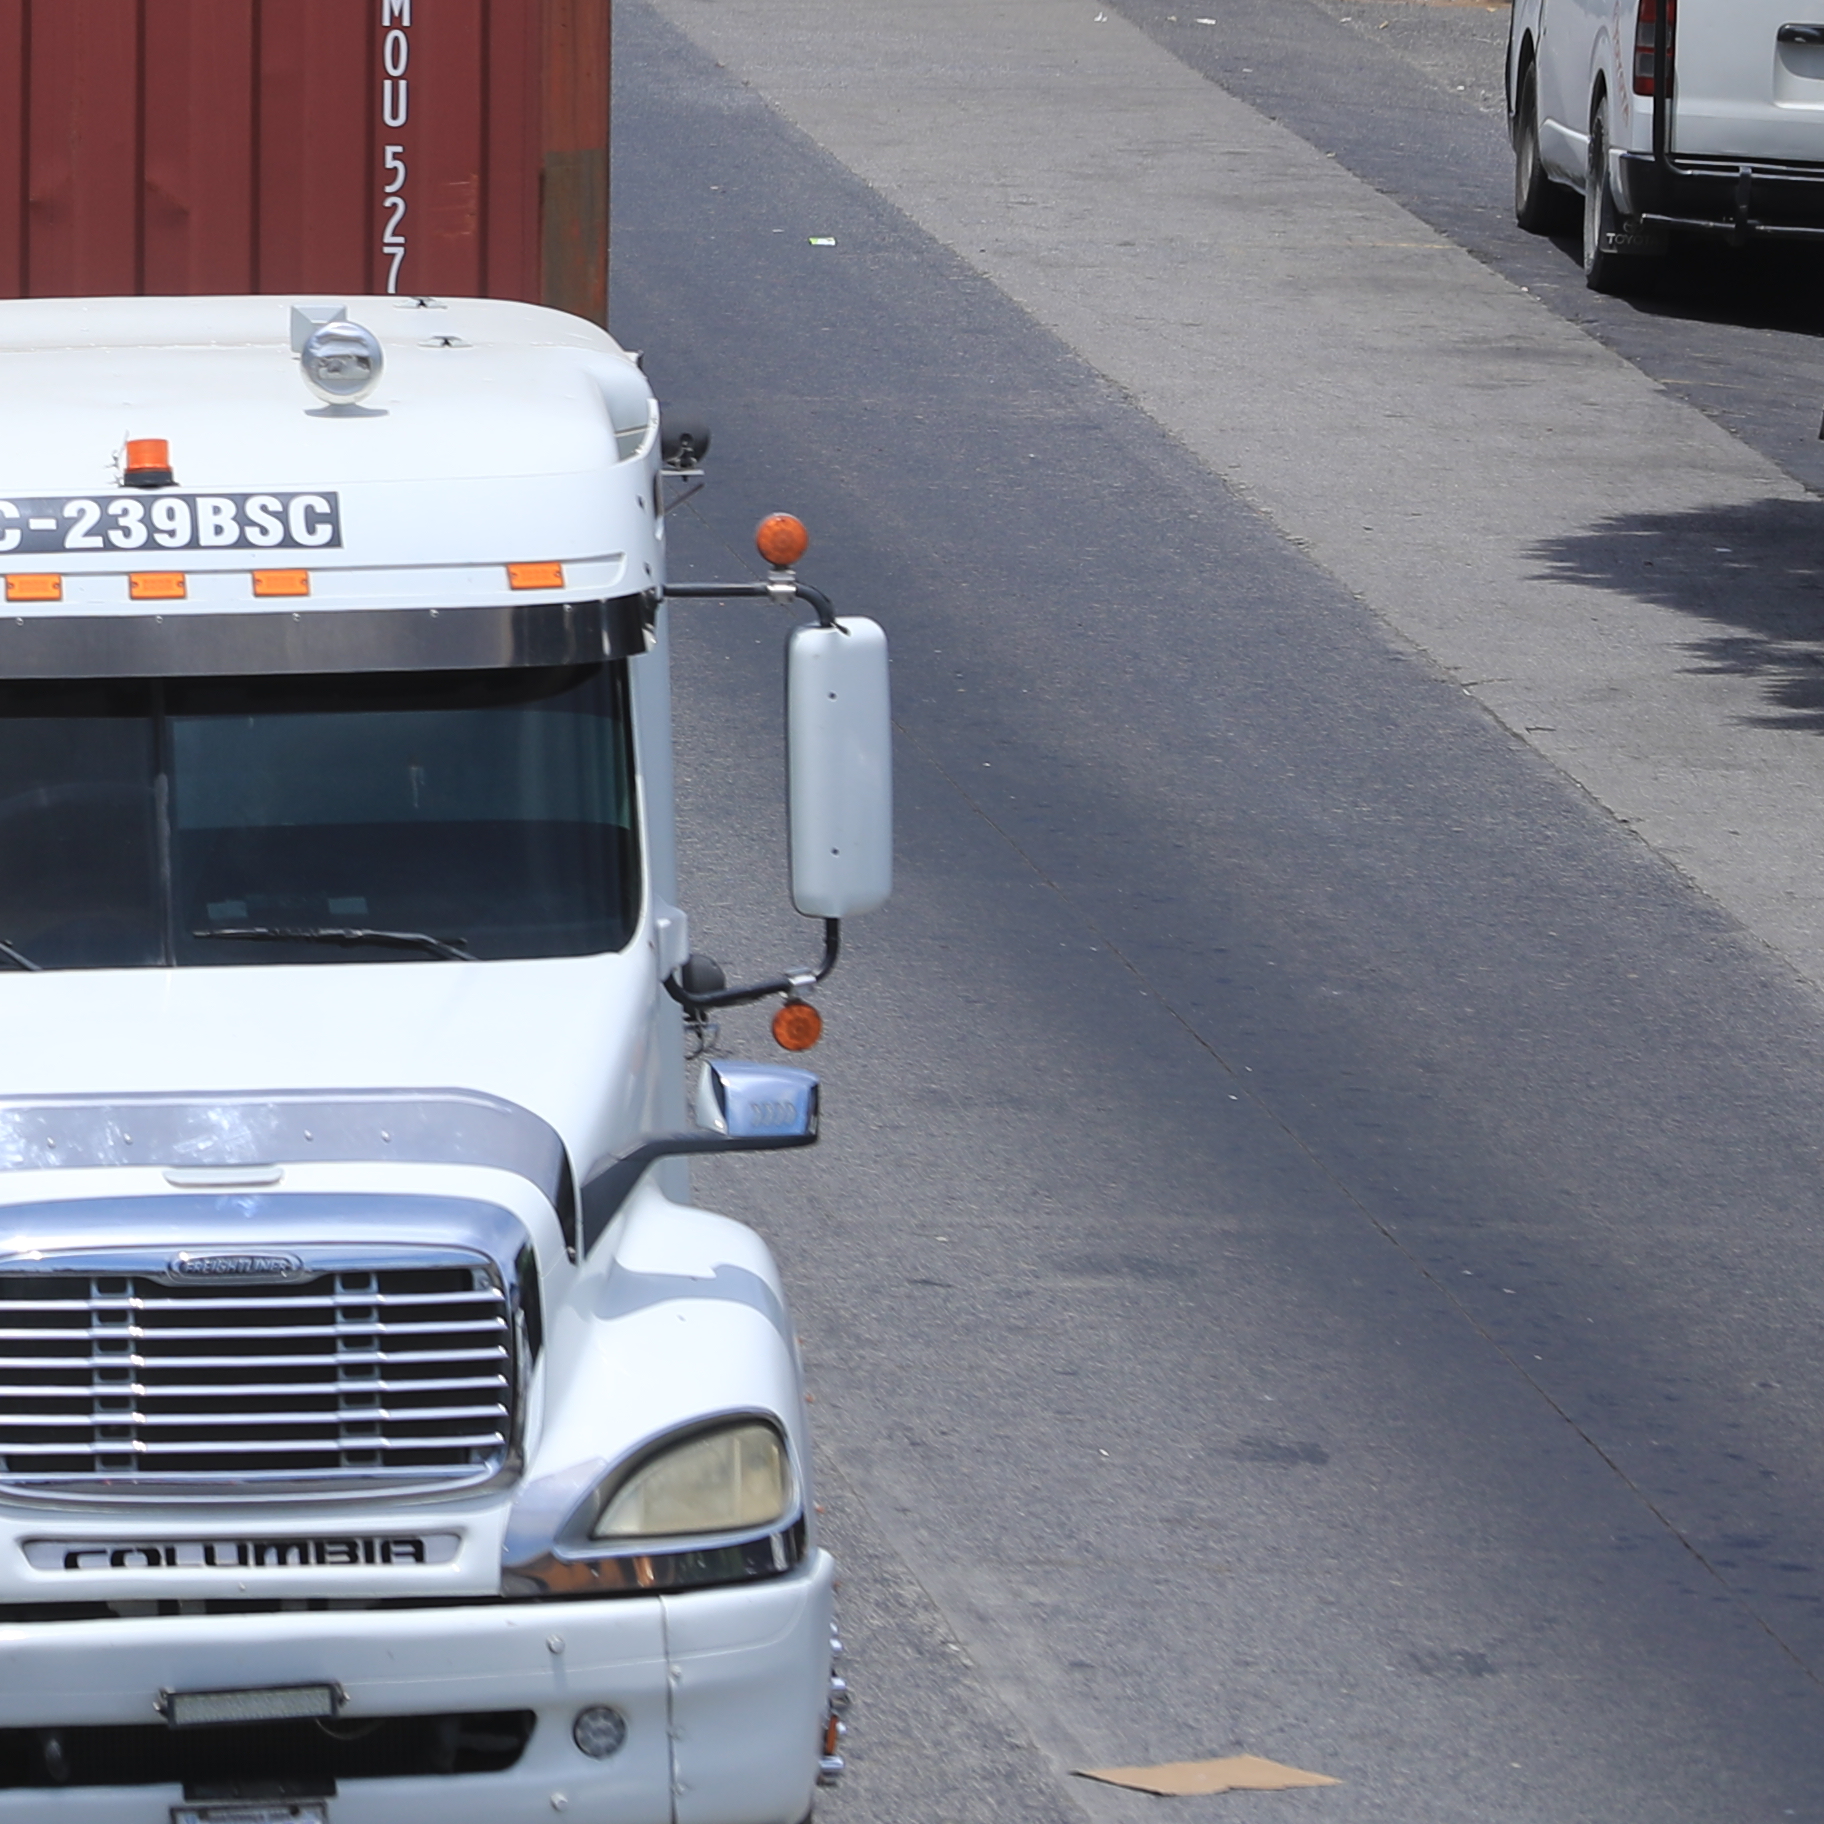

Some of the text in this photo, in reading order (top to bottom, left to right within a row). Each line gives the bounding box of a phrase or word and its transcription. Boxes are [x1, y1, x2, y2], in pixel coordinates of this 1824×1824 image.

[382, 145, 408, 295] 527
[184, 1257, 290, 1275] FREIGHTLINER
[63, 1538, 427, 1571] COLUMBIA
